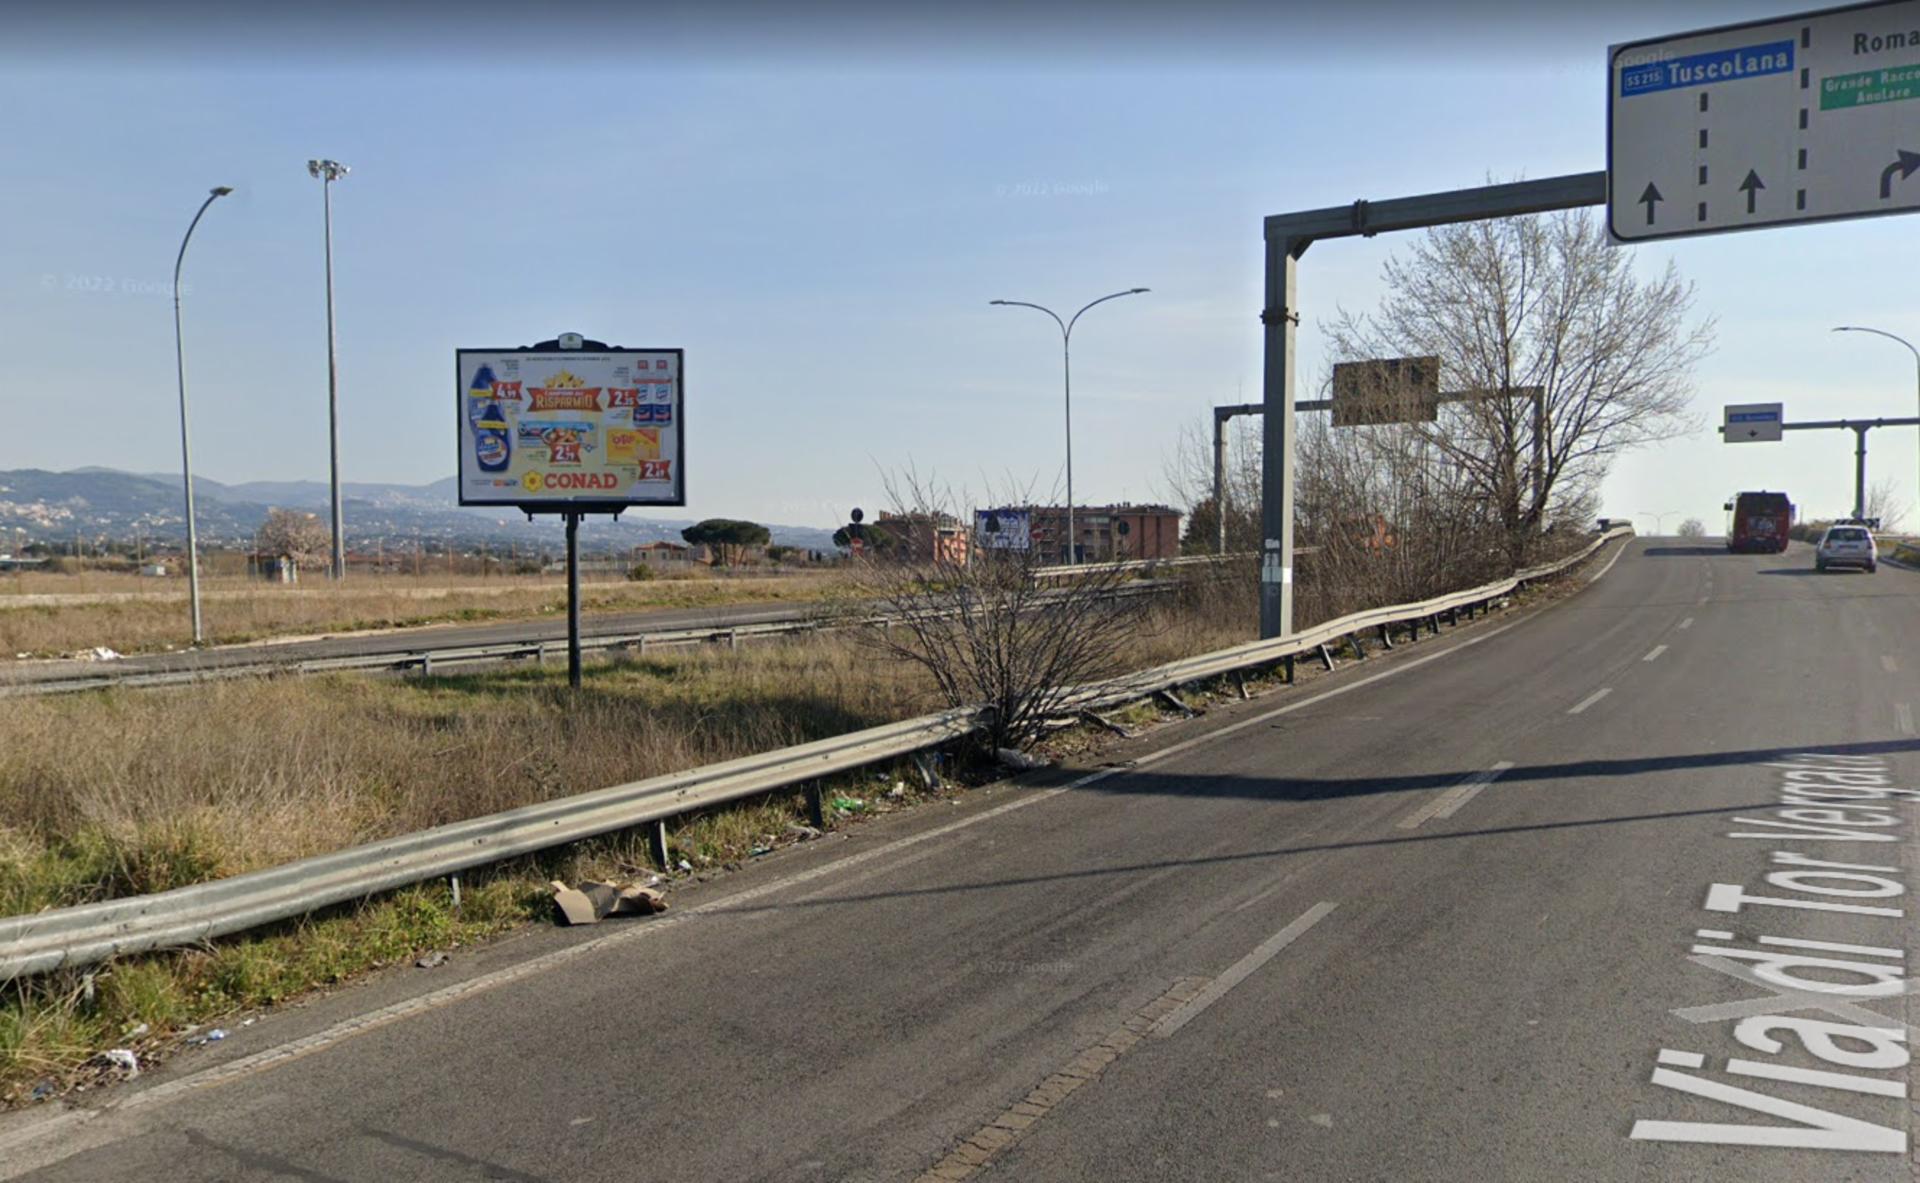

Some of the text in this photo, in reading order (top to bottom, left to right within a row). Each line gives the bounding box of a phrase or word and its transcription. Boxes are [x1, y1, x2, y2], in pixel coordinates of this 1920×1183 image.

[1853, 30, 1920, 55] Roma
[1668, 52, 1788, 84] Tuscolana
[1825, 75, 1872, 92] Grande
[535, 393, 594, 409] RISPARMIO
[543, 473, 618, 489] CONAD
